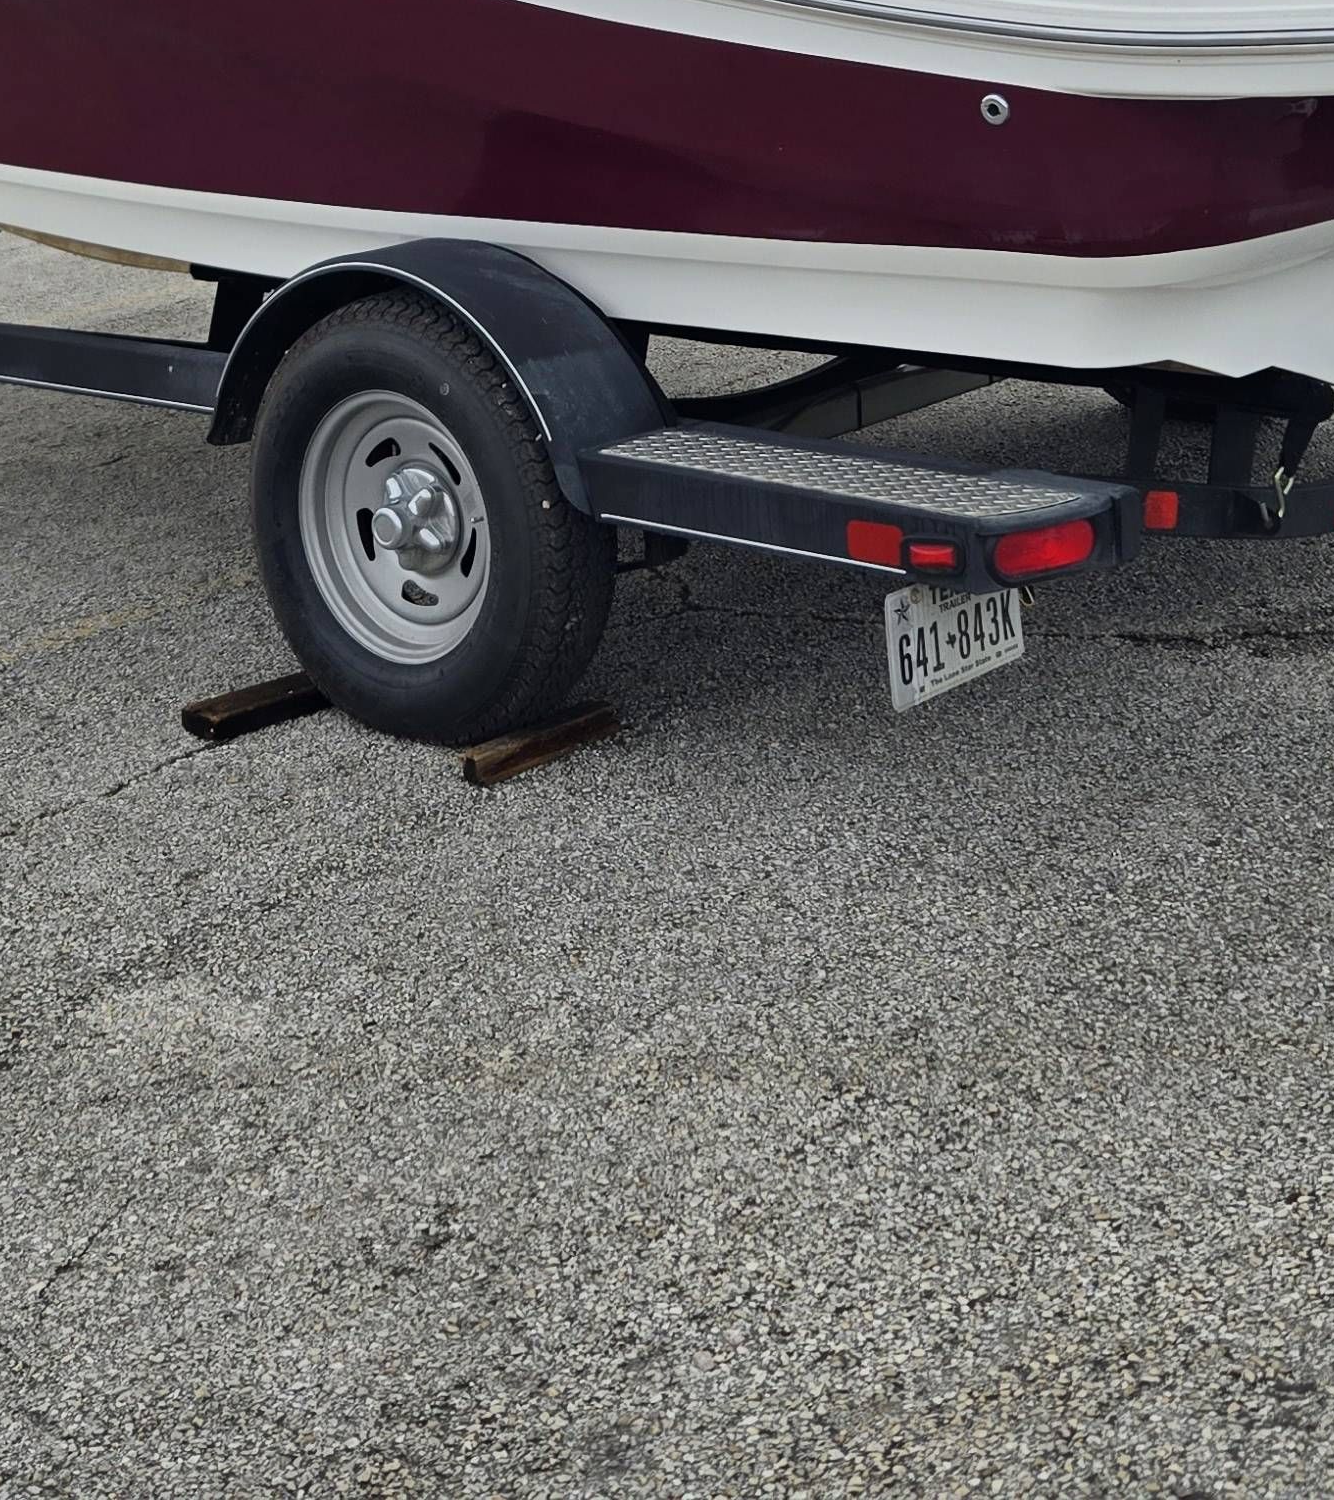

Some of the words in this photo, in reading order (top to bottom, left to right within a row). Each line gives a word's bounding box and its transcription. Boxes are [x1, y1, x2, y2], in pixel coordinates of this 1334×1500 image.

[938, 592, 971, 613] TRAILER
[898, 620, 945, 686] 641
[956, 589, 1016, 660] 843K
